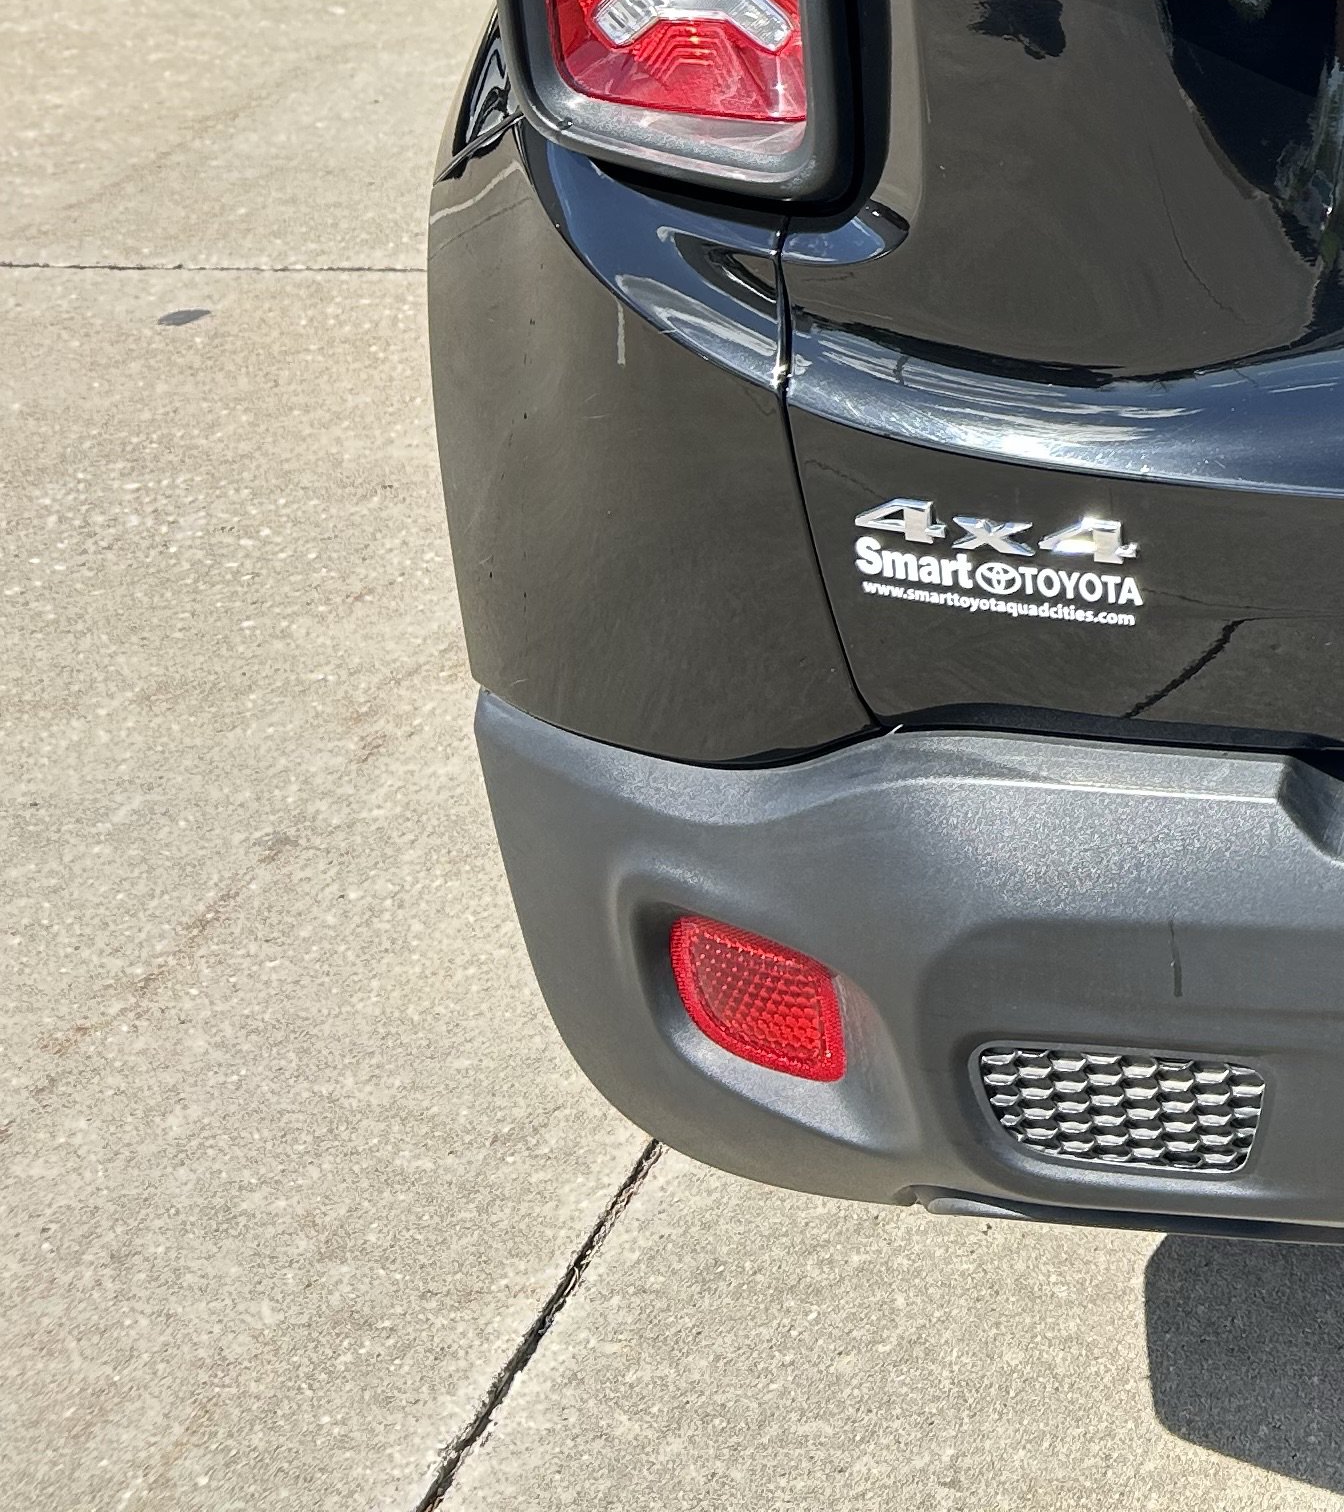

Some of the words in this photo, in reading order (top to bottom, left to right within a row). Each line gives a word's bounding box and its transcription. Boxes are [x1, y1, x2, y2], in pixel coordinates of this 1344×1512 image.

[854, 536, 974, 589] Smart
[1018, 566, 1144, 607] TOYOTA
[862, 581, 1136, 626] www.smarttoyotaquadcities.com
